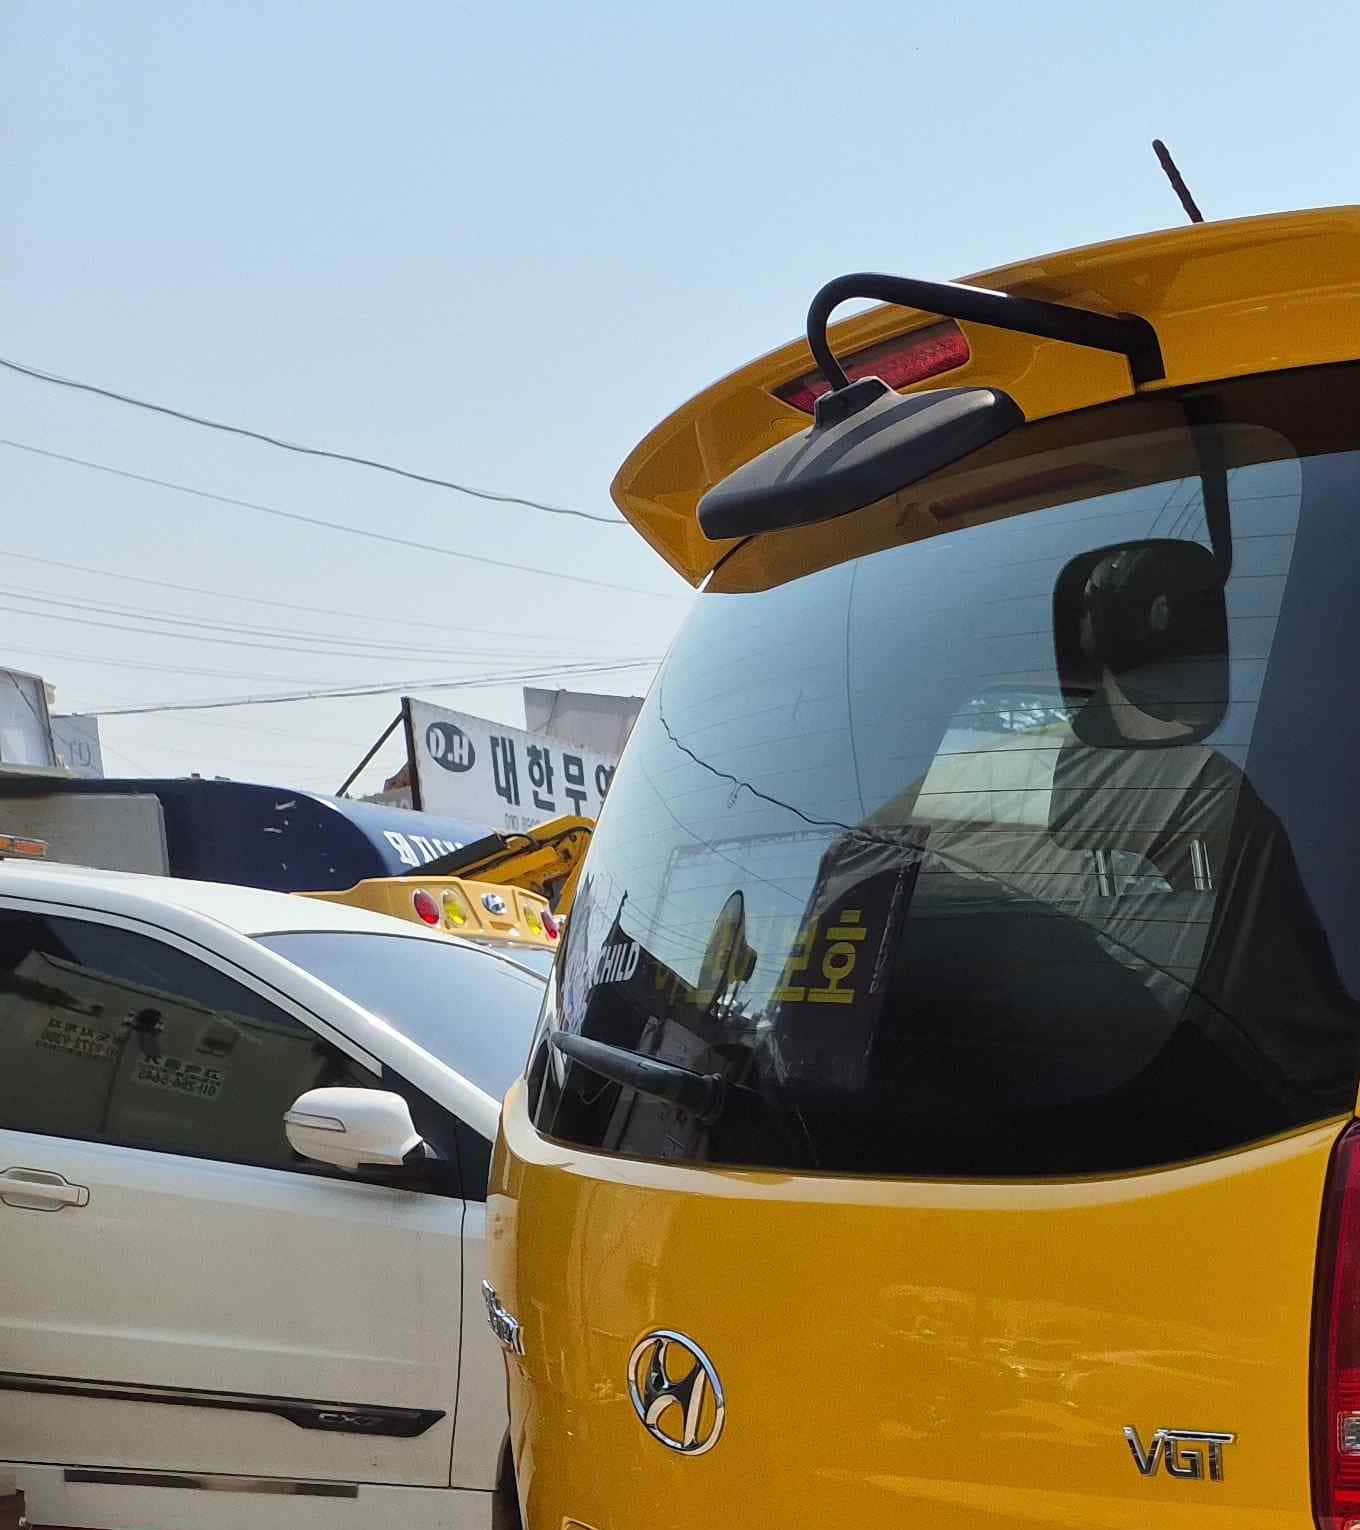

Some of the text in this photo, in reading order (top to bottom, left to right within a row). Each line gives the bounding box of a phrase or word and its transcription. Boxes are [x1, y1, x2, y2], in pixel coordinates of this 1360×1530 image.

[428, 727, 470, 767] D.H
[593, 941, 640, 985] CHILD
[1122, 1425, 1237, 1481] VGT
